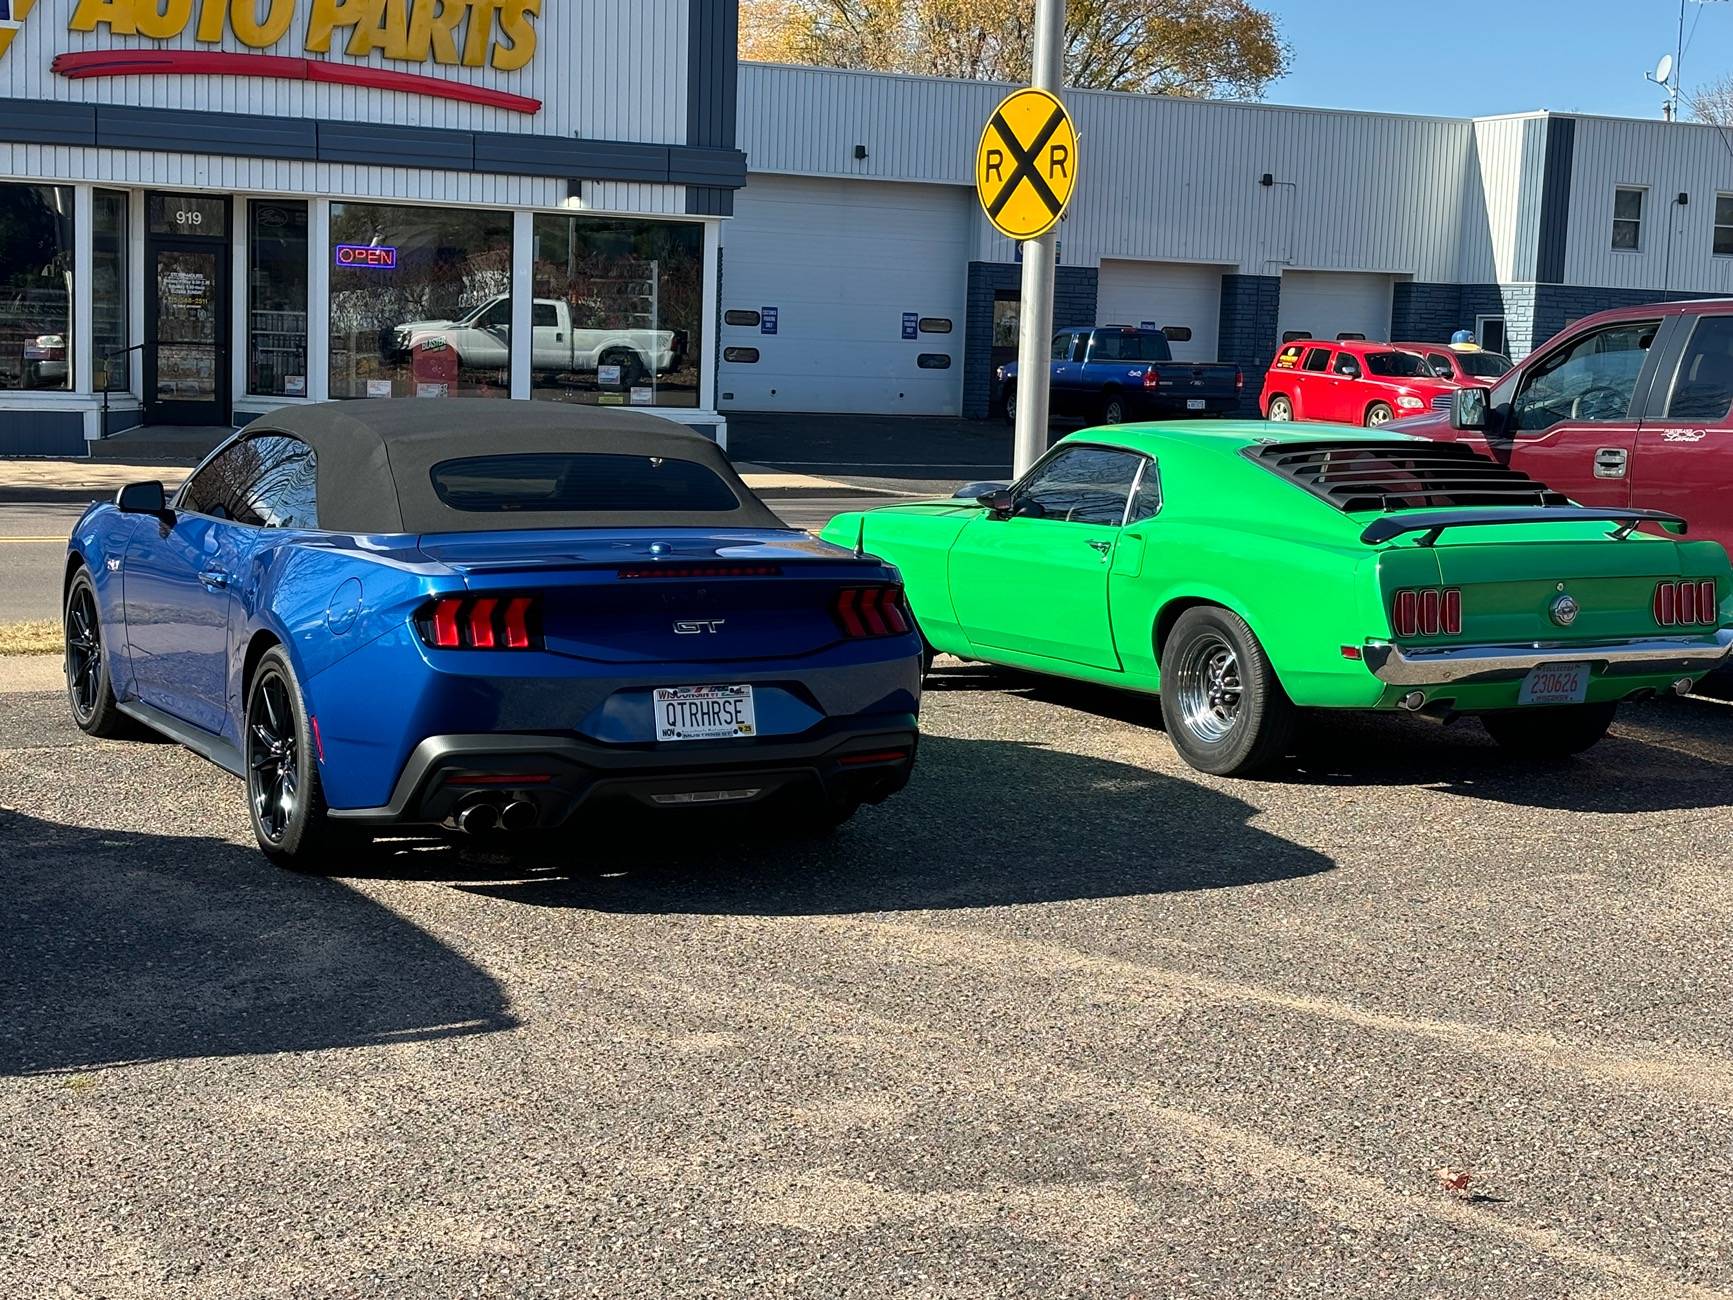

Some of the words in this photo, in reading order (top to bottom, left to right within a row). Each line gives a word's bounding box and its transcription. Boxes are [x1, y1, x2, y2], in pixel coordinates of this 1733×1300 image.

[304, 0, 541, 71] PARTS
[175, 211, 202, 225] 919
[339, 248, 393, 265] OPEN
[673, 619, 725, 634] GT
[1530, 672, 1578, 694] 230626
[666, 699, 745, 727] QTRHRSE
[662, 728, 675, 737] NOV
